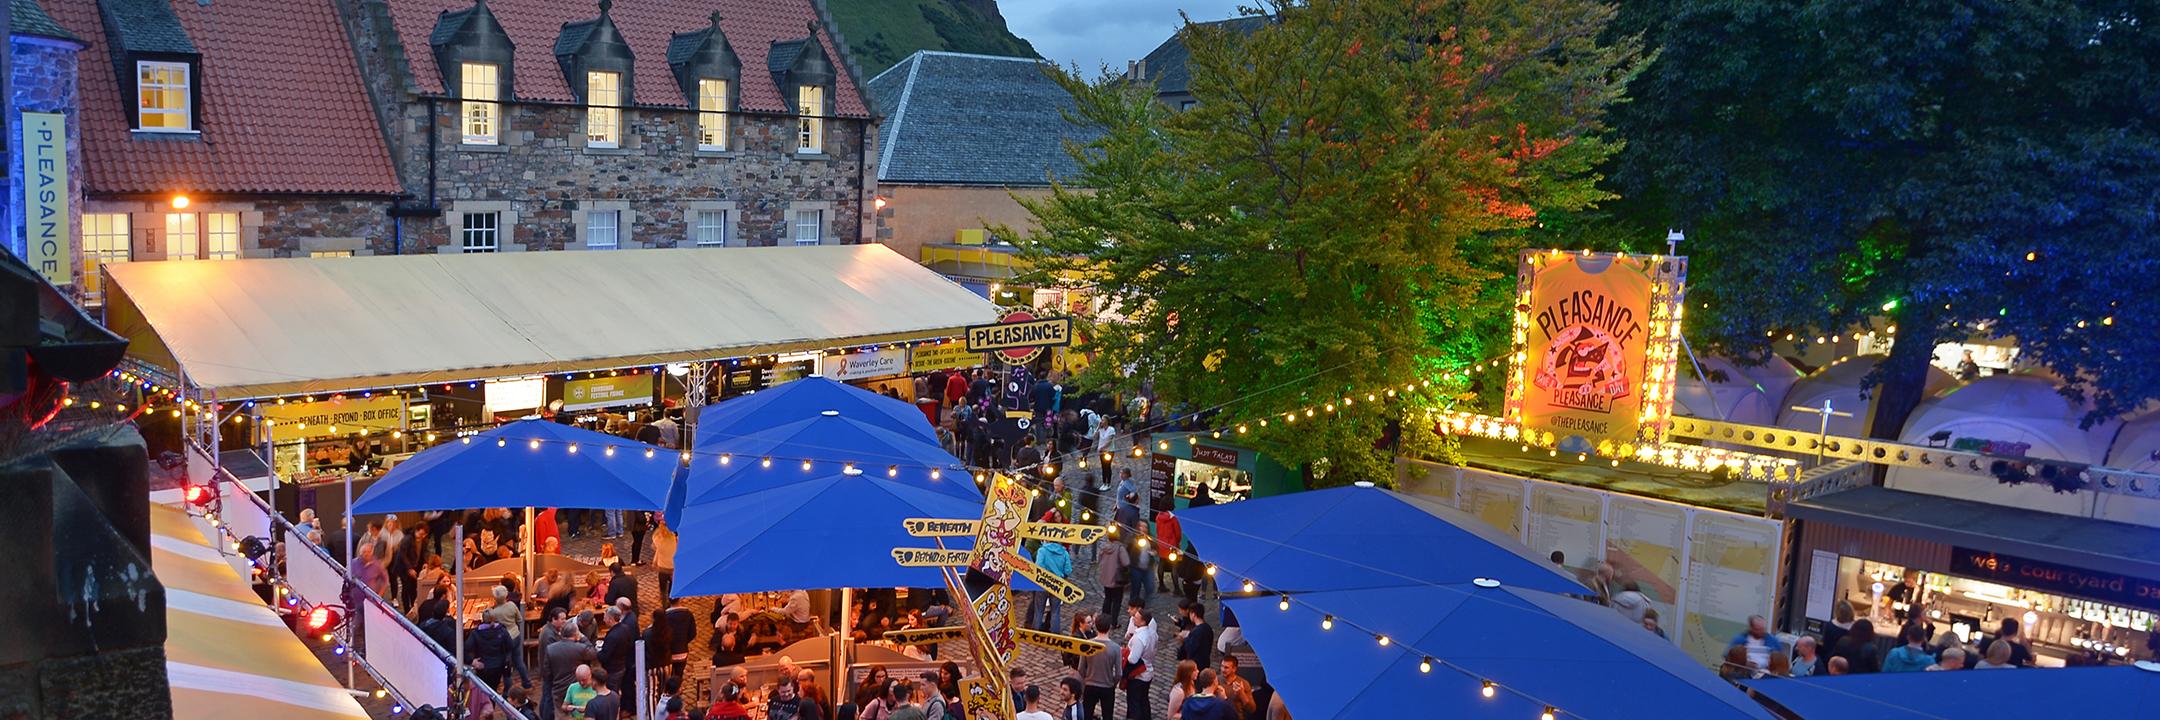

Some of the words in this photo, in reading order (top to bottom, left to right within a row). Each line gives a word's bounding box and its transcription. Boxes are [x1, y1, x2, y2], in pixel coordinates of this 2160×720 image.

[37, 128, 58, 274] PLEASANCE
[1536, 289, 1643, 350] PLEASANCE
[975, 322, 1063, 347] PLEASANCE
[849, 358, 878, 369] Waverley
[879, 356, 894, 366] Care
[1553, 388, 1605, 411] PLEASANCE
[299, 414, 329, 427] BENEATH
[333, 411, 358, 425] BEYOND
[363, 408, 377, 421] BOX
[377, 407, 399, 419] OFFICE
[1551, 415, 1608, 434] @THEPLEASANCE
[926, 521, 973, 534] BENEATH
[914, 551, 941, 563] BEYOND
[946, 551, 970, 564] FORTH
[1035, 575, 1061, 594] LONDON
[1036, 567, 1064, 588] PLEASANCE
[1032, 633, 1073, 649] CELLAR
